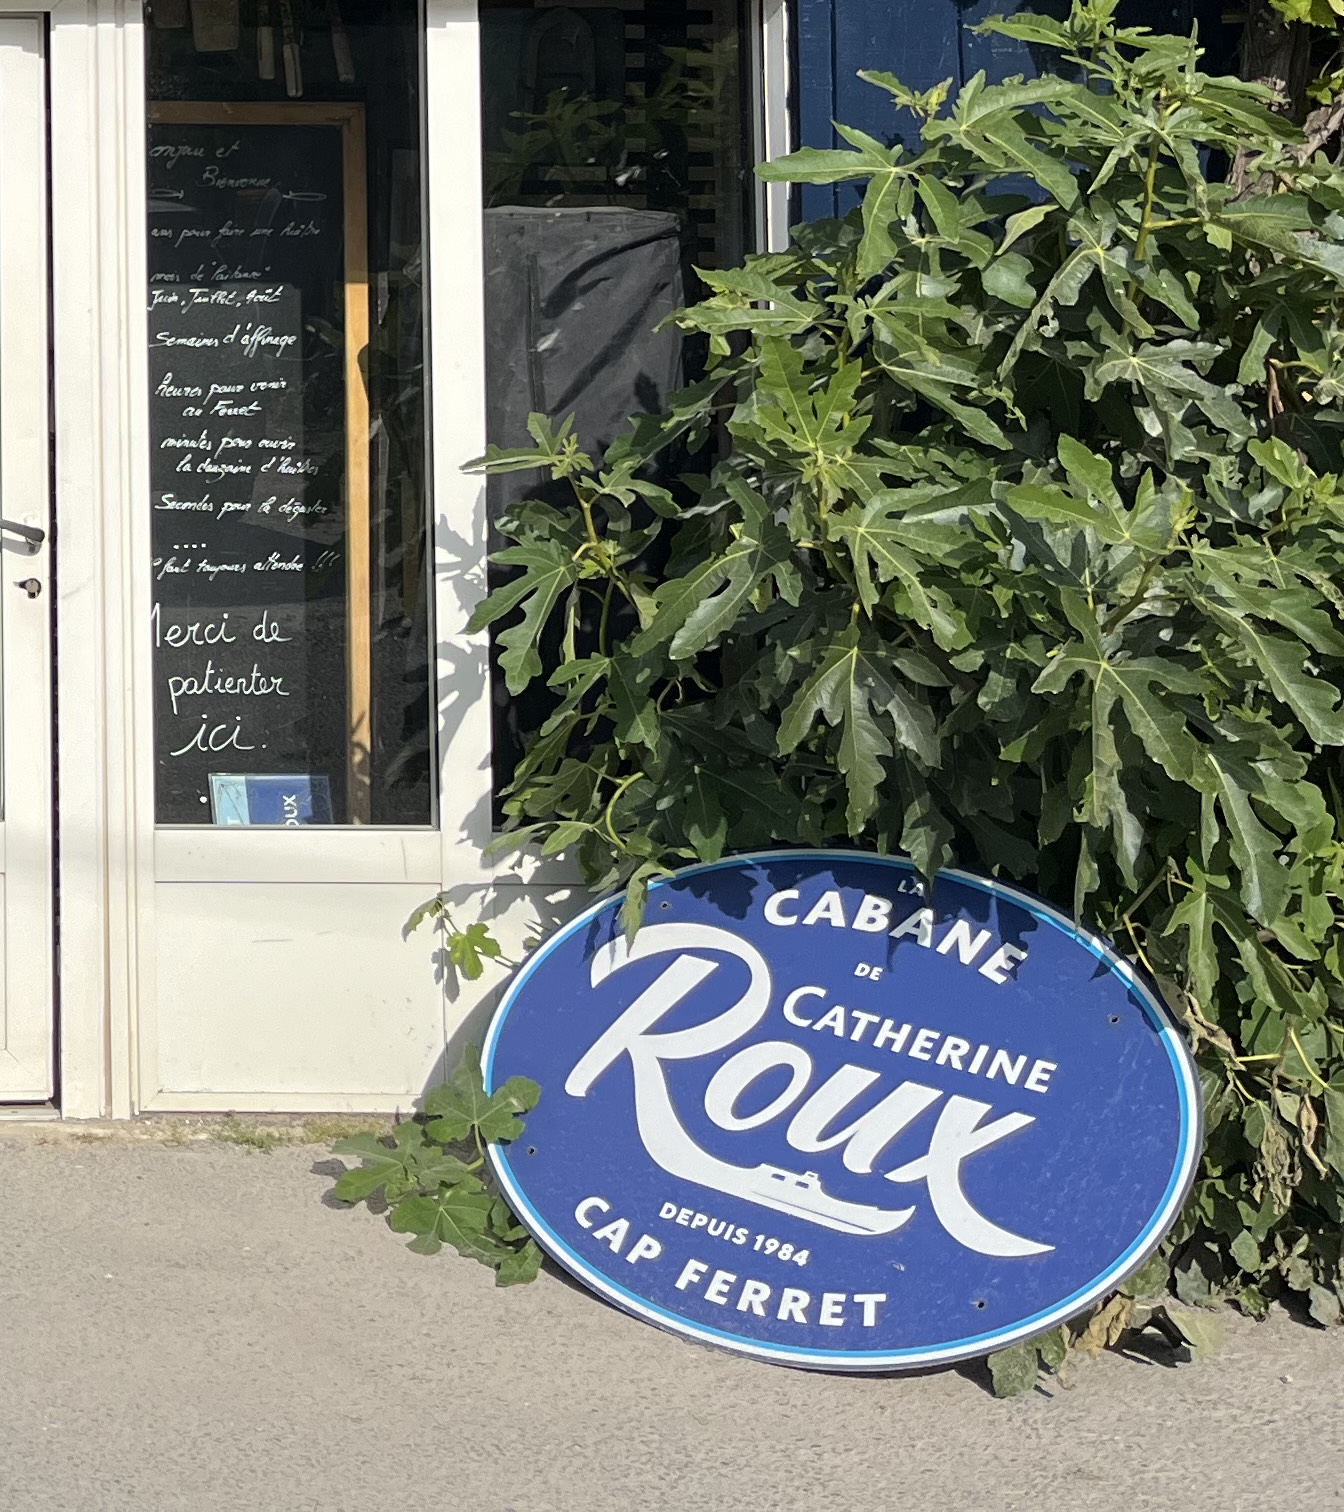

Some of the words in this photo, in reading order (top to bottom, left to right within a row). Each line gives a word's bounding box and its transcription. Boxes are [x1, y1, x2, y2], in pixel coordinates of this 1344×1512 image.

[176, 453, 192, 472] la
[253, 610, 293, 643] de
[168, 659, 290, 715] patienter
[762, 888, 1029, 986] CABANE
[853, 962, 884, 982] DE
[572, 1195, 664, 1267] CAP
[673, 1259, 887, 1328] FERRET
[658, 1201, 749, 1253] DEPUIS
[753, 1231, 812, 1269] 1984
